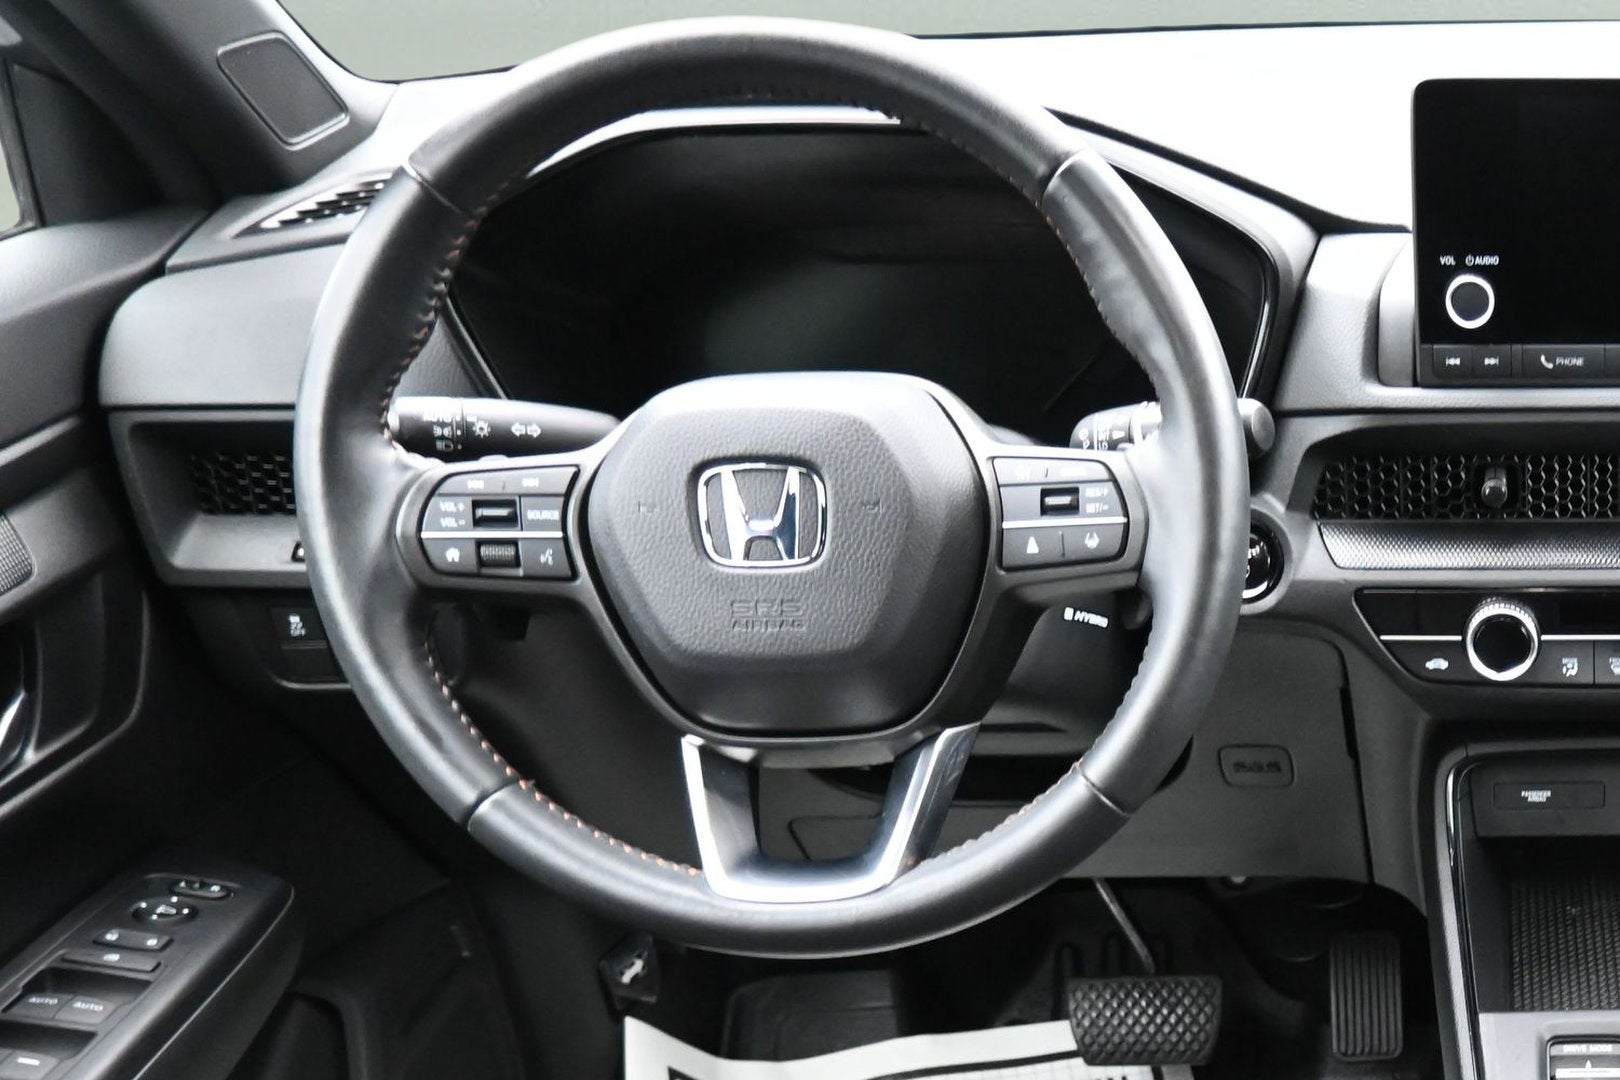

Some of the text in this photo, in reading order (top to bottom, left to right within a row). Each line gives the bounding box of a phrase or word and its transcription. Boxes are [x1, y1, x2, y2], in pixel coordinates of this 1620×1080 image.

[1440, 255, 1500, 266] VOL AUDIO
[1556, 356, 1585, 367] PHONE
